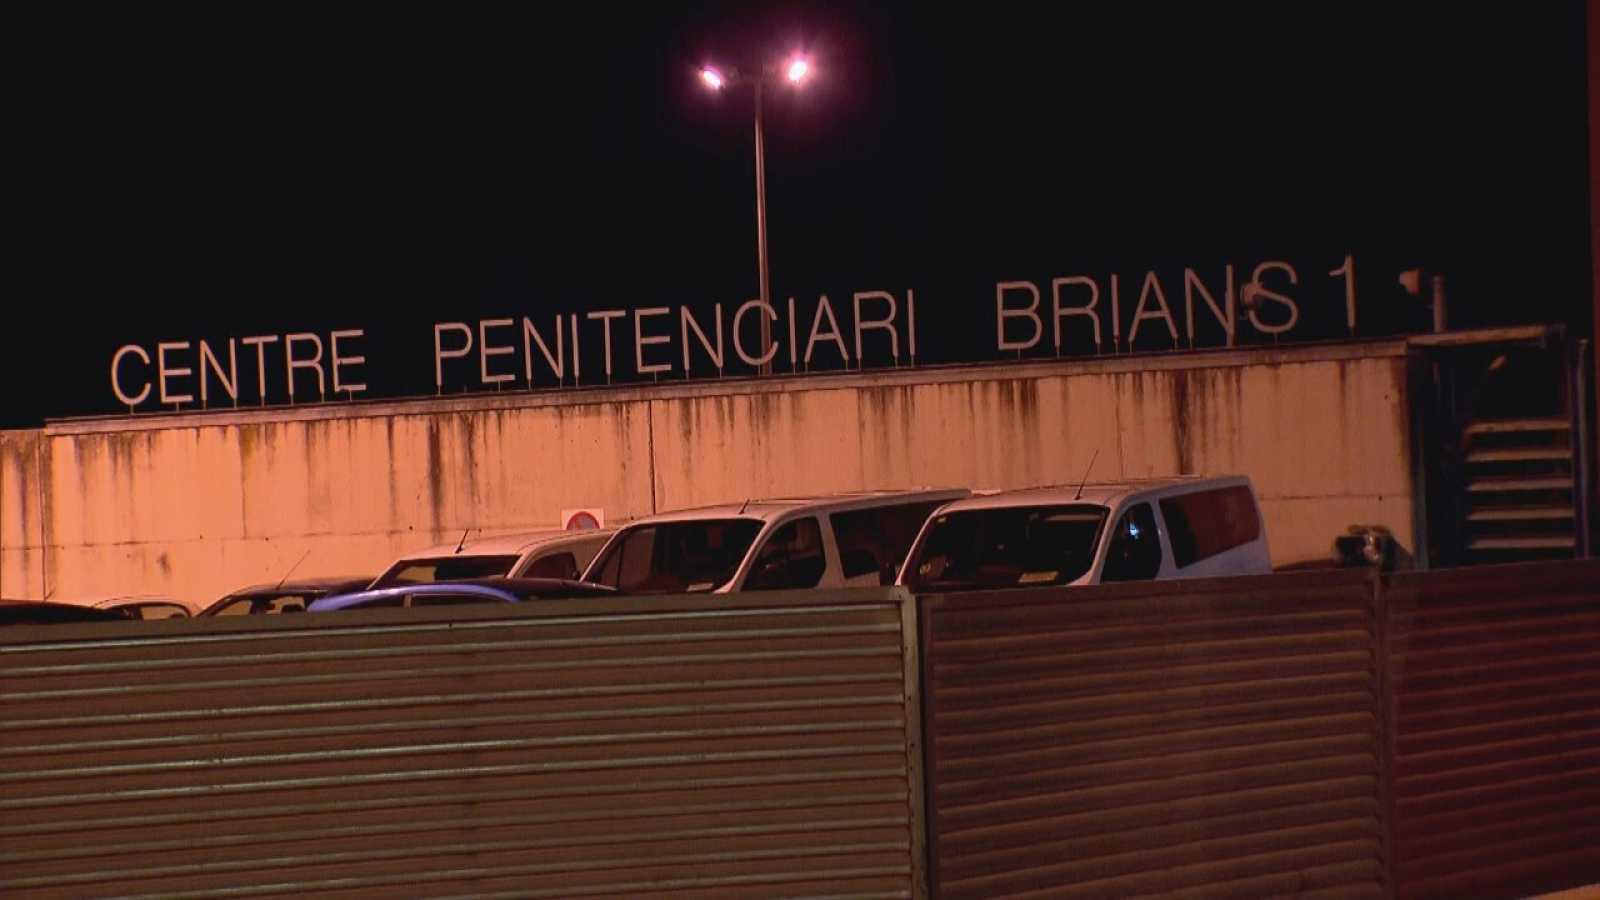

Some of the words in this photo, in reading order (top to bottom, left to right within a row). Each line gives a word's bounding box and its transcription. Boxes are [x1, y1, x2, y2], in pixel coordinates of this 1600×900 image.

[111, 329, 367, 405] CENTRE
[434, 289, 915, 386] PENITENCIARI
[996, 261, 1298, 350] BRIANS
[1328, 255, 1356, 328] 1
